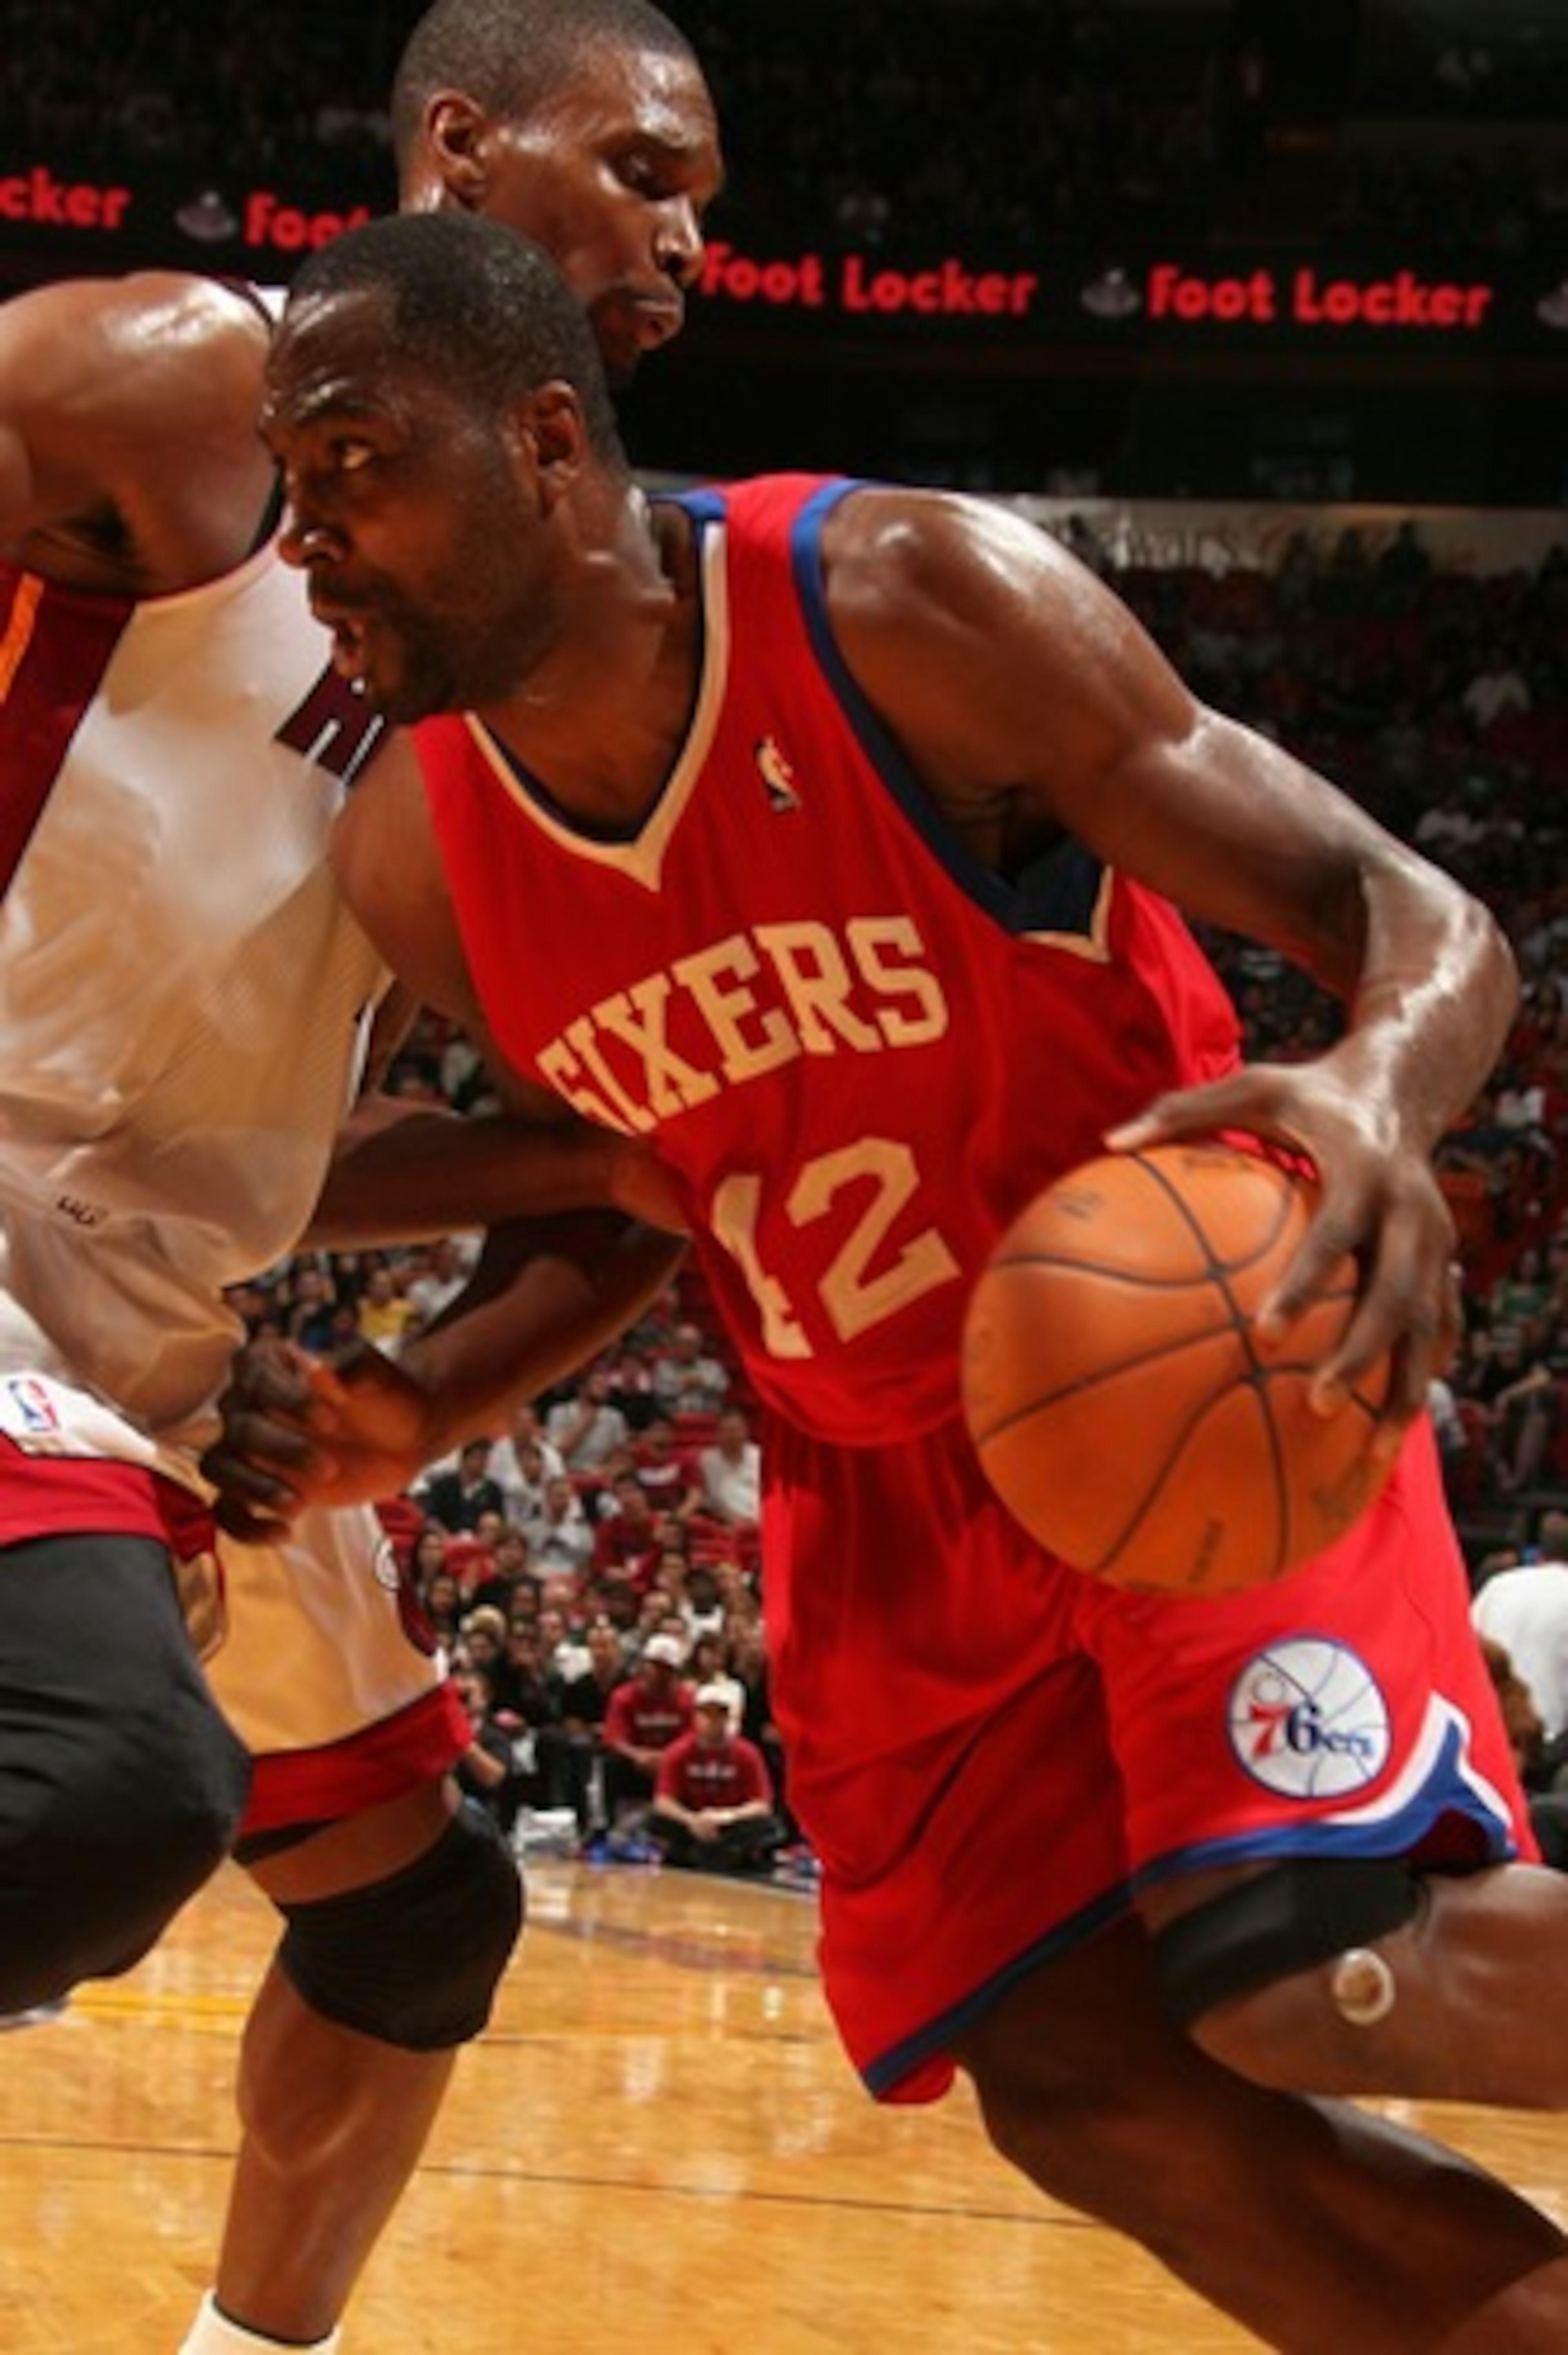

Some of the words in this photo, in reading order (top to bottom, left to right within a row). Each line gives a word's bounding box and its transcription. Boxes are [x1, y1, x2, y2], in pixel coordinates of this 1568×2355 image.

[701, 242, 822, 304] Foot
[843, 256, 1035, 313] Locker
[1148, 265, 1273, 321] Foot
[1295, 270, 1490, 325] Locker
[712, 1137, 961, 1358] 12
